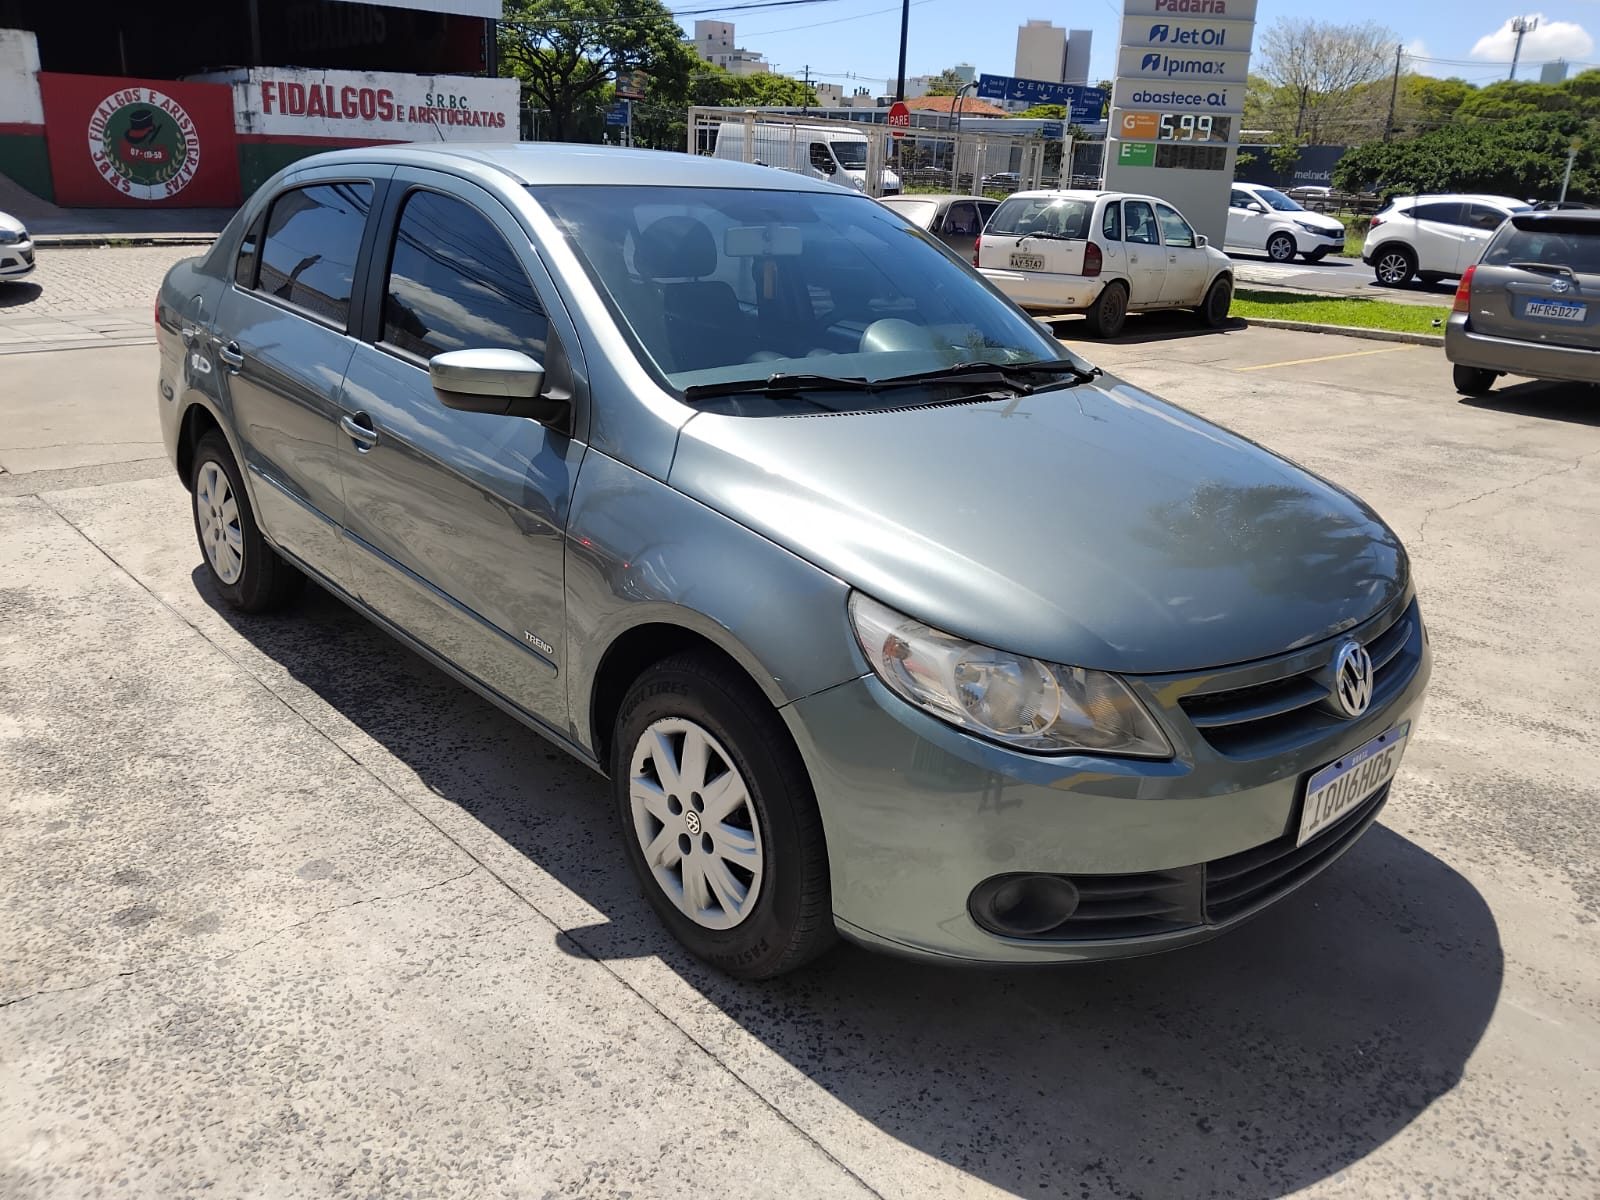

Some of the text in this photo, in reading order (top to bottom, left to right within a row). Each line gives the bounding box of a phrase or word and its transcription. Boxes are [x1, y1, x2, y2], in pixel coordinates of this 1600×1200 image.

[1162, 55, 1226, 77] Ipimax
[1017, 81, 1075, 95] CENTRO
[261, 81, 394, 122] FIDALGOS
[396, 105, 506, 128] E ARISTOCRATAS
[890, 114, 909, 126] PARE
[1123, 115, 1136, 129] G
[90, 89, 199, 196] FIDALGOS E ARISTOCRATAS
[1121, 143, 1132, 157] E
[1294, 169, 1332, 181] melnick
[1530, 303, 1579, 319] HFR5D27
[524, 630, 553, 654] TREND
[1309, 745, 1397, 832] IQU6H05
